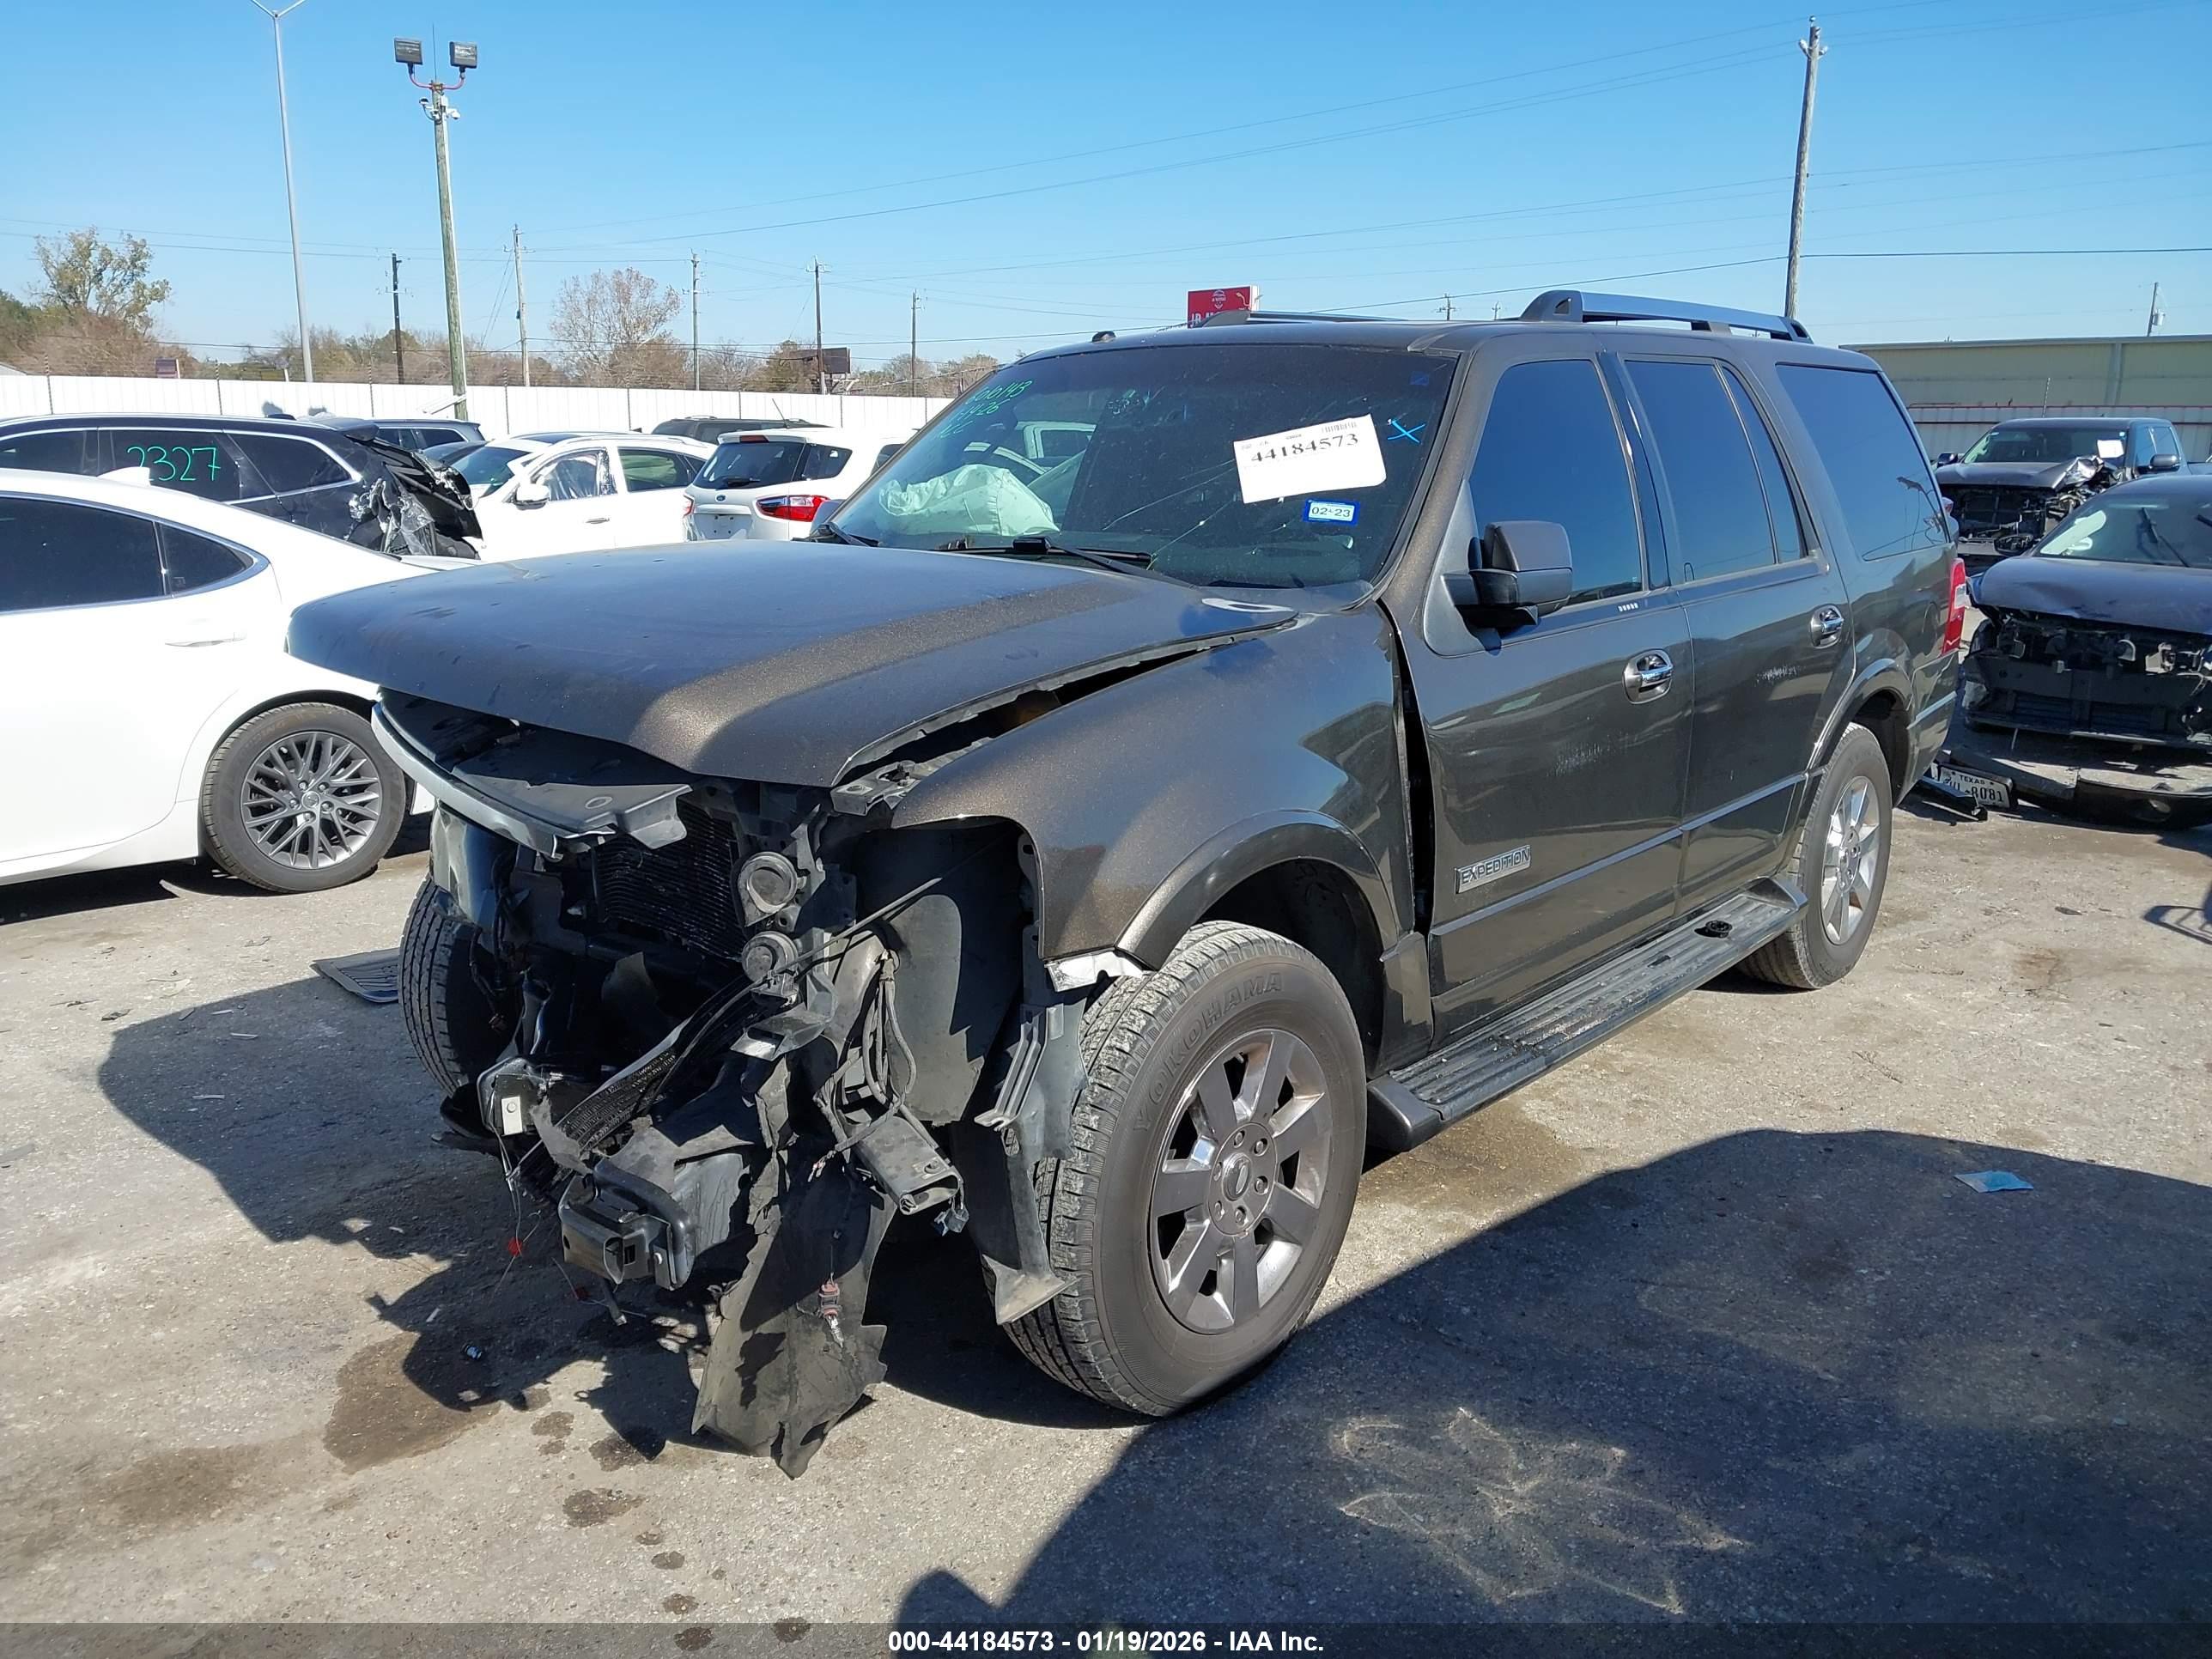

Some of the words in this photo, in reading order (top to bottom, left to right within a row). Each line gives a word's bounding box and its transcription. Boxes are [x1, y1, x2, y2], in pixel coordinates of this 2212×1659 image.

[126, 446, 222, 481] 2327
[1251, 433, 1358, 462] 44184573
[1960, 775, 1985, 785] TEXAS
[1462, 847, 1530, 884] EXPEDITION
[1133, 972, 1283, 1132] YOKOHAMA
